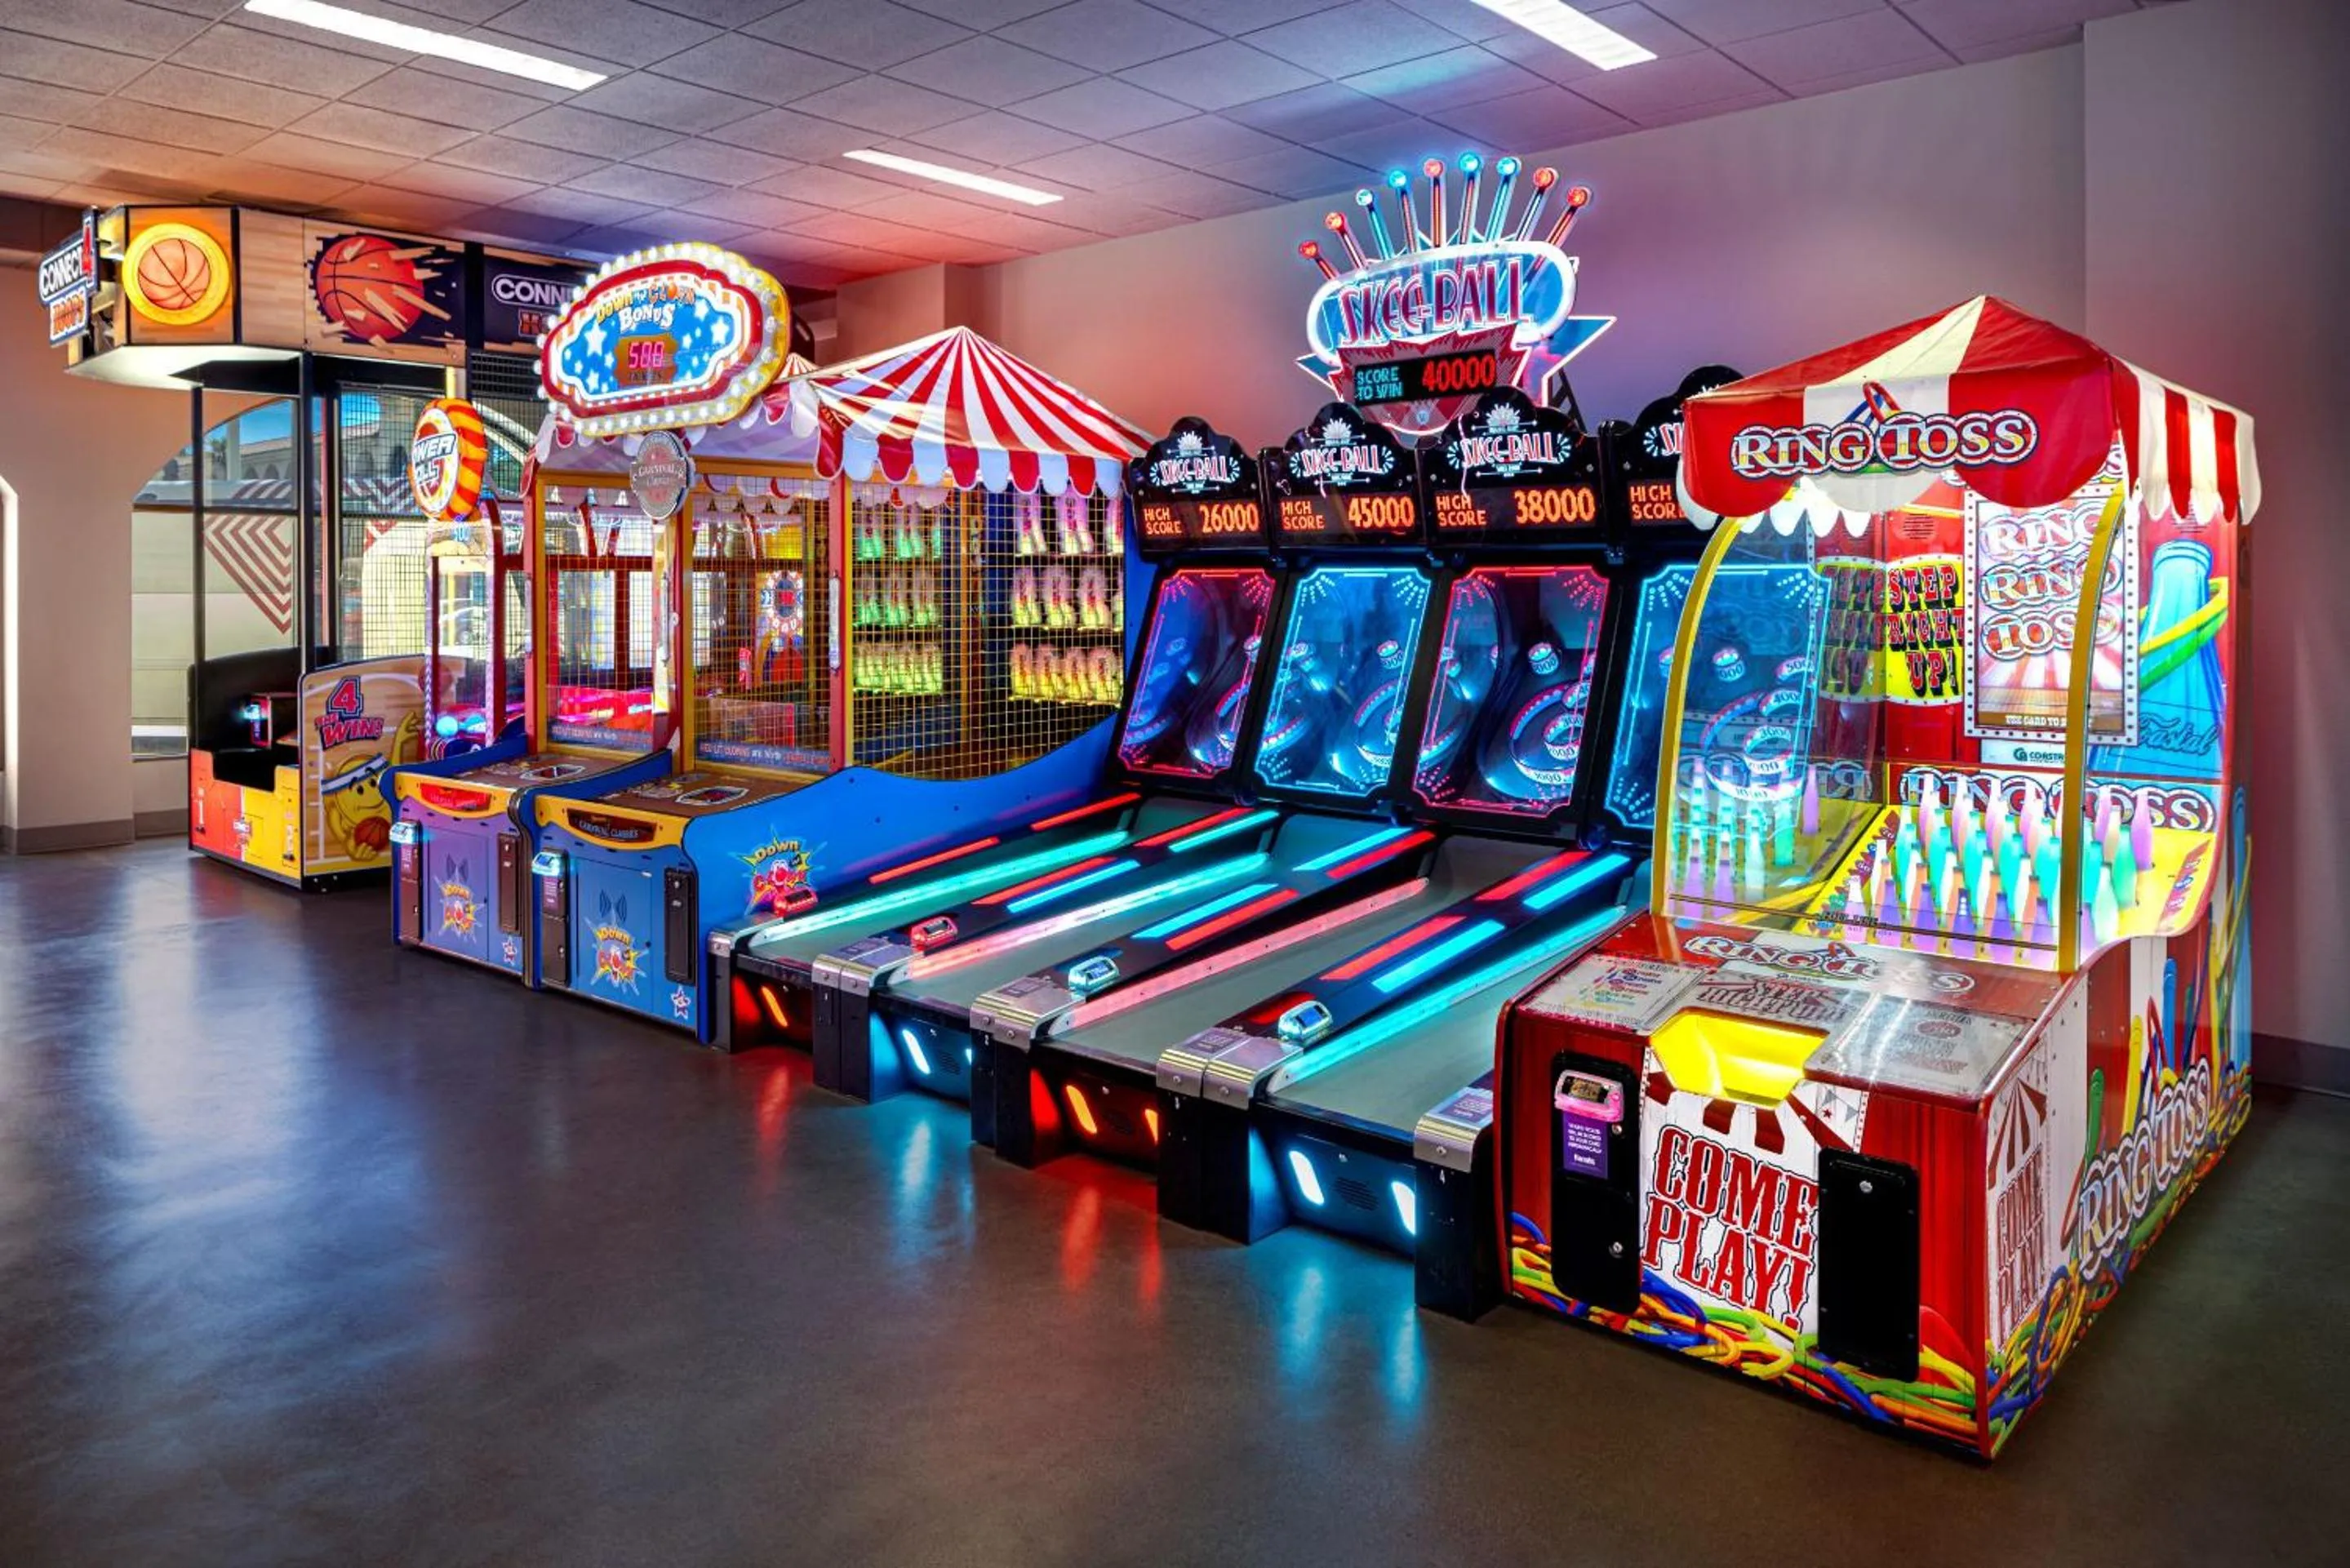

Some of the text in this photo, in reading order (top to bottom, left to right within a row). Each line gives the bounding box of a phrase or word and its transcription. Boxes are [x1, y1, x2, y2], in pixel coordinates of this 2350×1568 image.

[618, 302, 677, 335] BONUS
[1356, 354, 1497, 393] SCORE 40000
[1356, 383, 1404, 401] TO WIN
[1733, 429, 1868, 472] RING
[1880, 418, 2027, 463] TOSS
[1434, 487, 1596, 525] HIGH 38000
[1630, 484, 1673, 503] HIGH
[1143, 502, 1260, 534] HIGH 26000
[1144, 520, 1184, 535] SCORE
[1281, 495, 1415, 530] HIGH 45000
[1282, 515, 1326, 531] SCORE
[1437, 509, 1487, 527] SCORE
[1888, 563, 1957, 610] STEP
[1886, 607, 1964, 649] RIGHT
[1905, 648, 1959, 695] UP!
[331, 679, 359, 714] 4
[2047, 717, 2059, 726] TO
[2029, 751, 2065, 761] COASTA
[1691, 935, 1824, 971] RING
[2079, 1066, 2210, 1273] RING TOSS
[1653, 1125, 1819, 1258] COME
[1641, 1193, 1815, 1332] PLAY!
